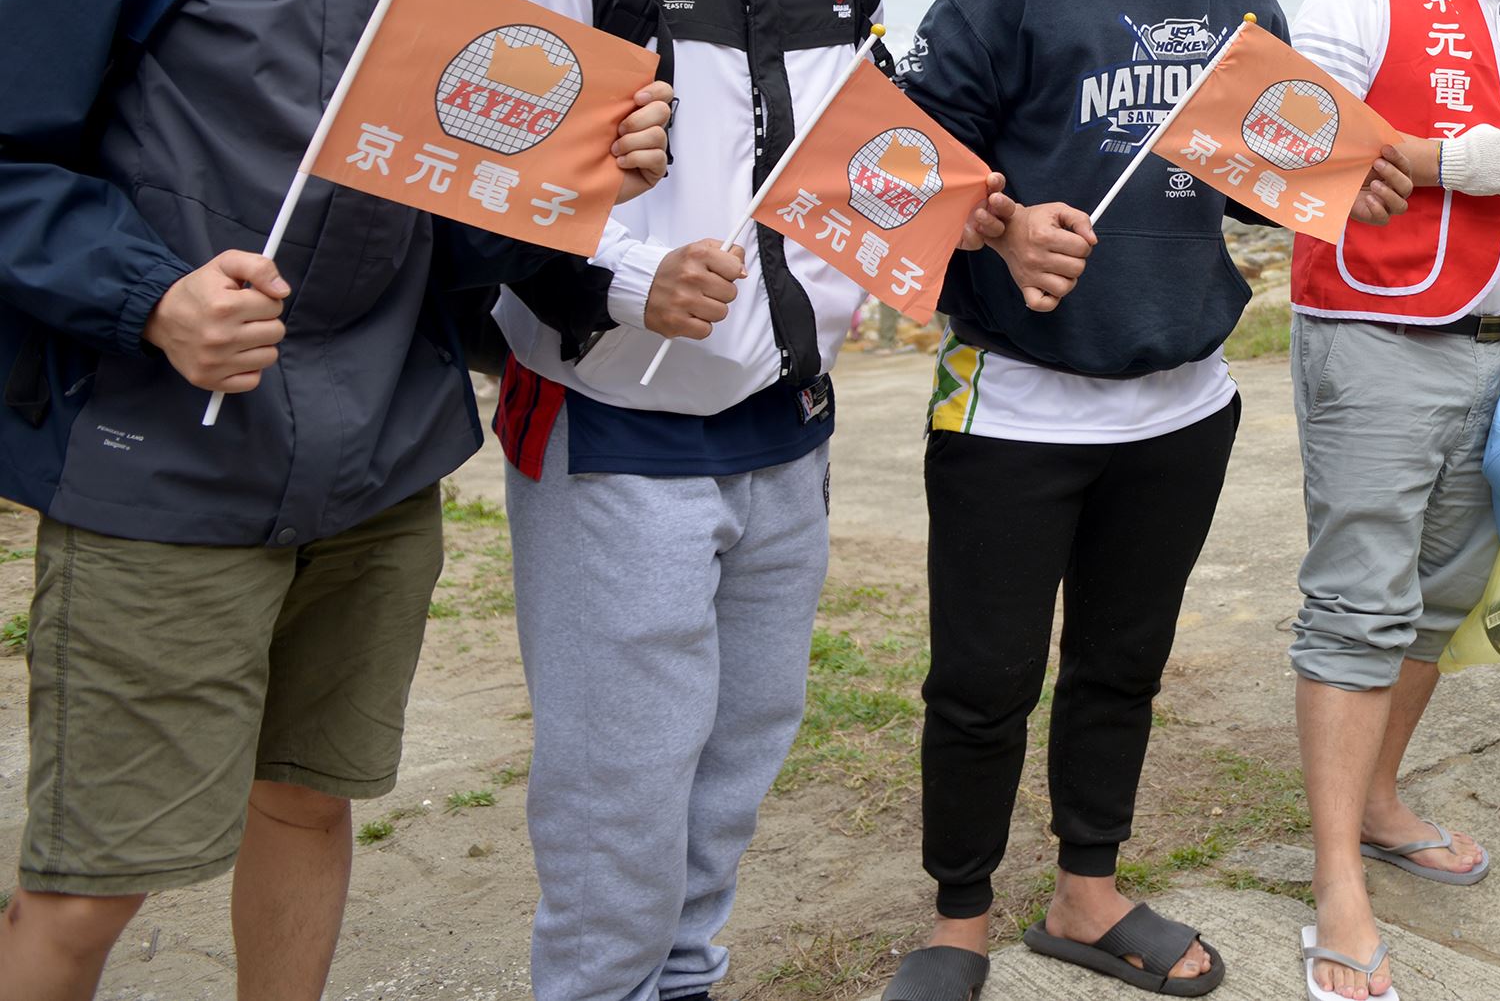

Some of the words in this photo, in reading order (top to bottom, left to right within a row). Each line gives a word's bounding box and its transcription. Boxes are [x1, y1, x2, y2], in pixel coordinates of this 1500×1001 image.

[1155, 40, 1209, 53] HOCKEY
[441, 79, 561, 136] KYEC
[1127, 111, 1154, 124] SAN
[1247, 112, 1327, 164] KYEC
[346, 122, 579, 227] 京元電子
[853, 164, 925, 218] KYEC
[1165, 190, 1197, 198] TOYOTA
[1180, 128, 1326, 223] 京元電子
[776, 188, 926, 296] 京元電子
